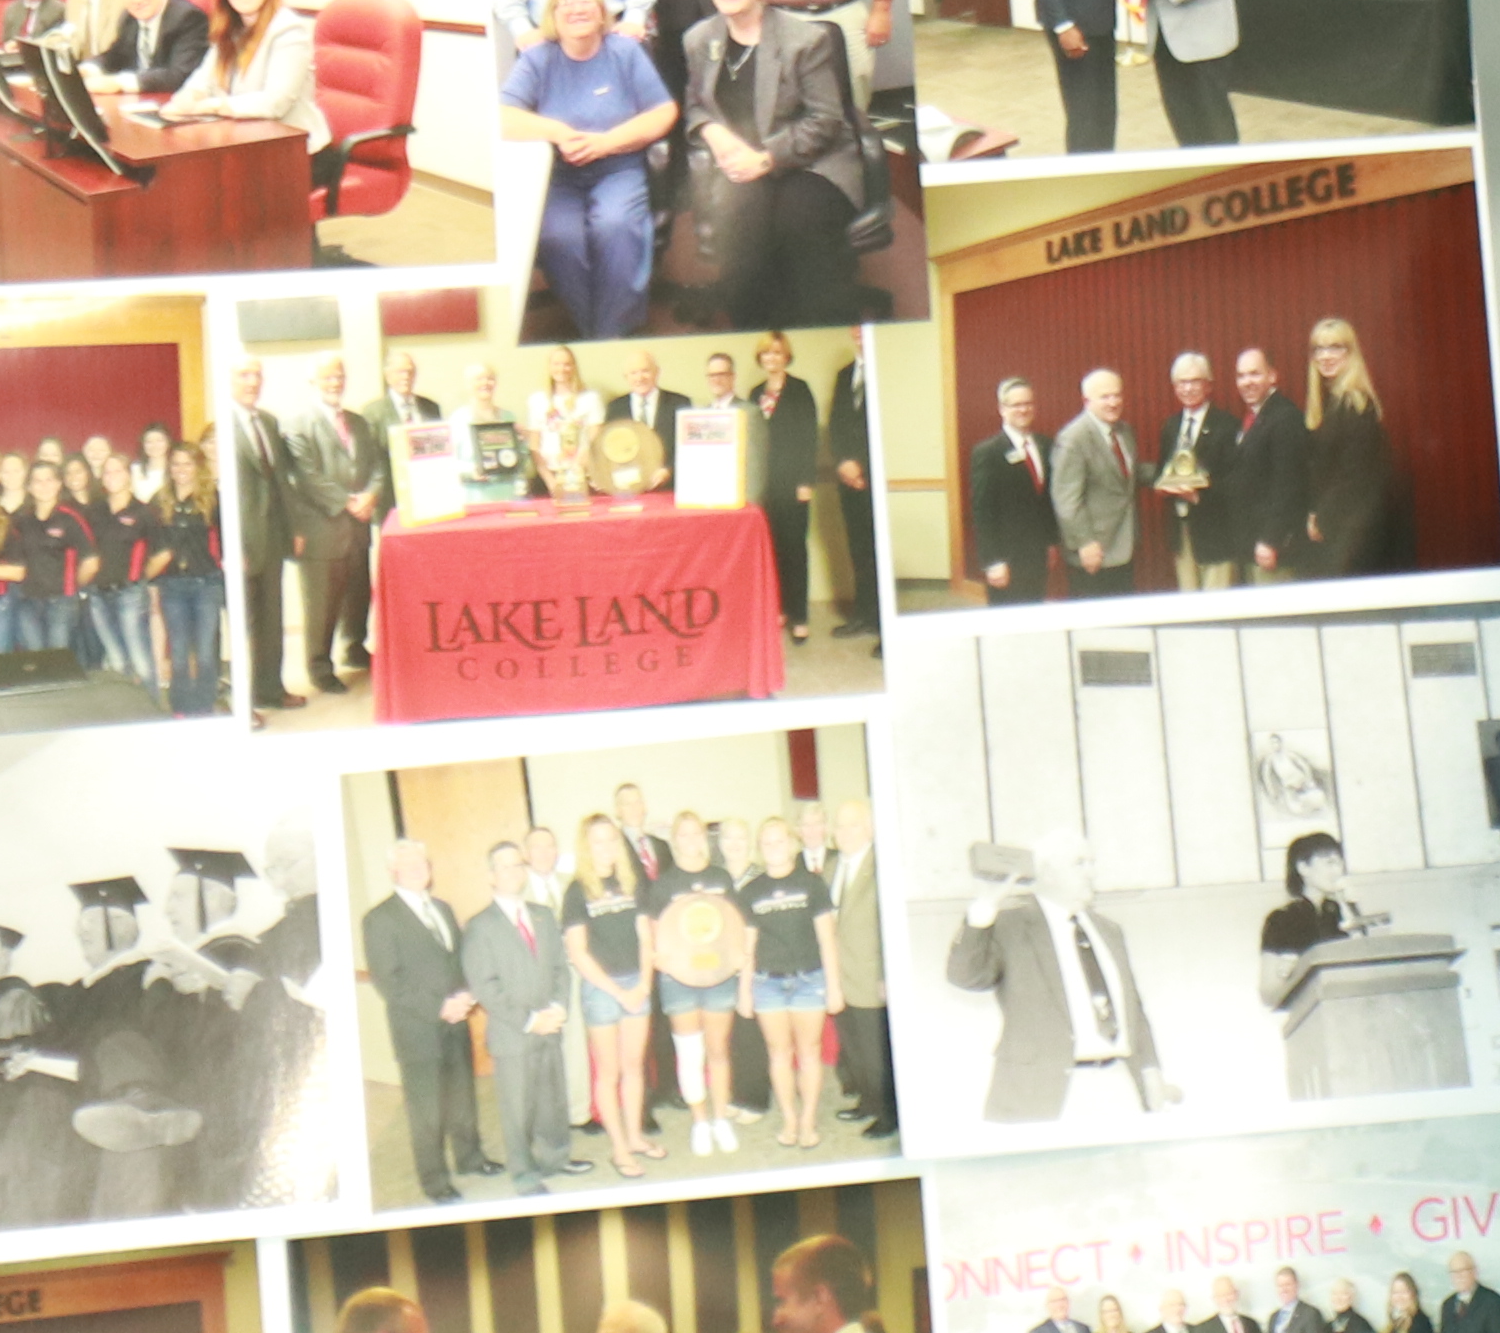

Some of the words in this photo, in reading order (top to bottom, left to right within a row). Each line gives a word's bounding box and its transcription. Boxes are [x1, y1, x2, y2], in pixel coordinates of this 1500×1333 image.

[1044, 225, 1104, 265] LAKE
[1113, 204, 1189, 249] LAND
[1203, 162, 1356, 226] COLLEGE
[424, 597, 562, 653] LAKE
[572, 585, 721, 647] LAND
[458, 647, 695, 682] COLLEGE
[1164, 1209, 1348, 1274] INSPIRE
